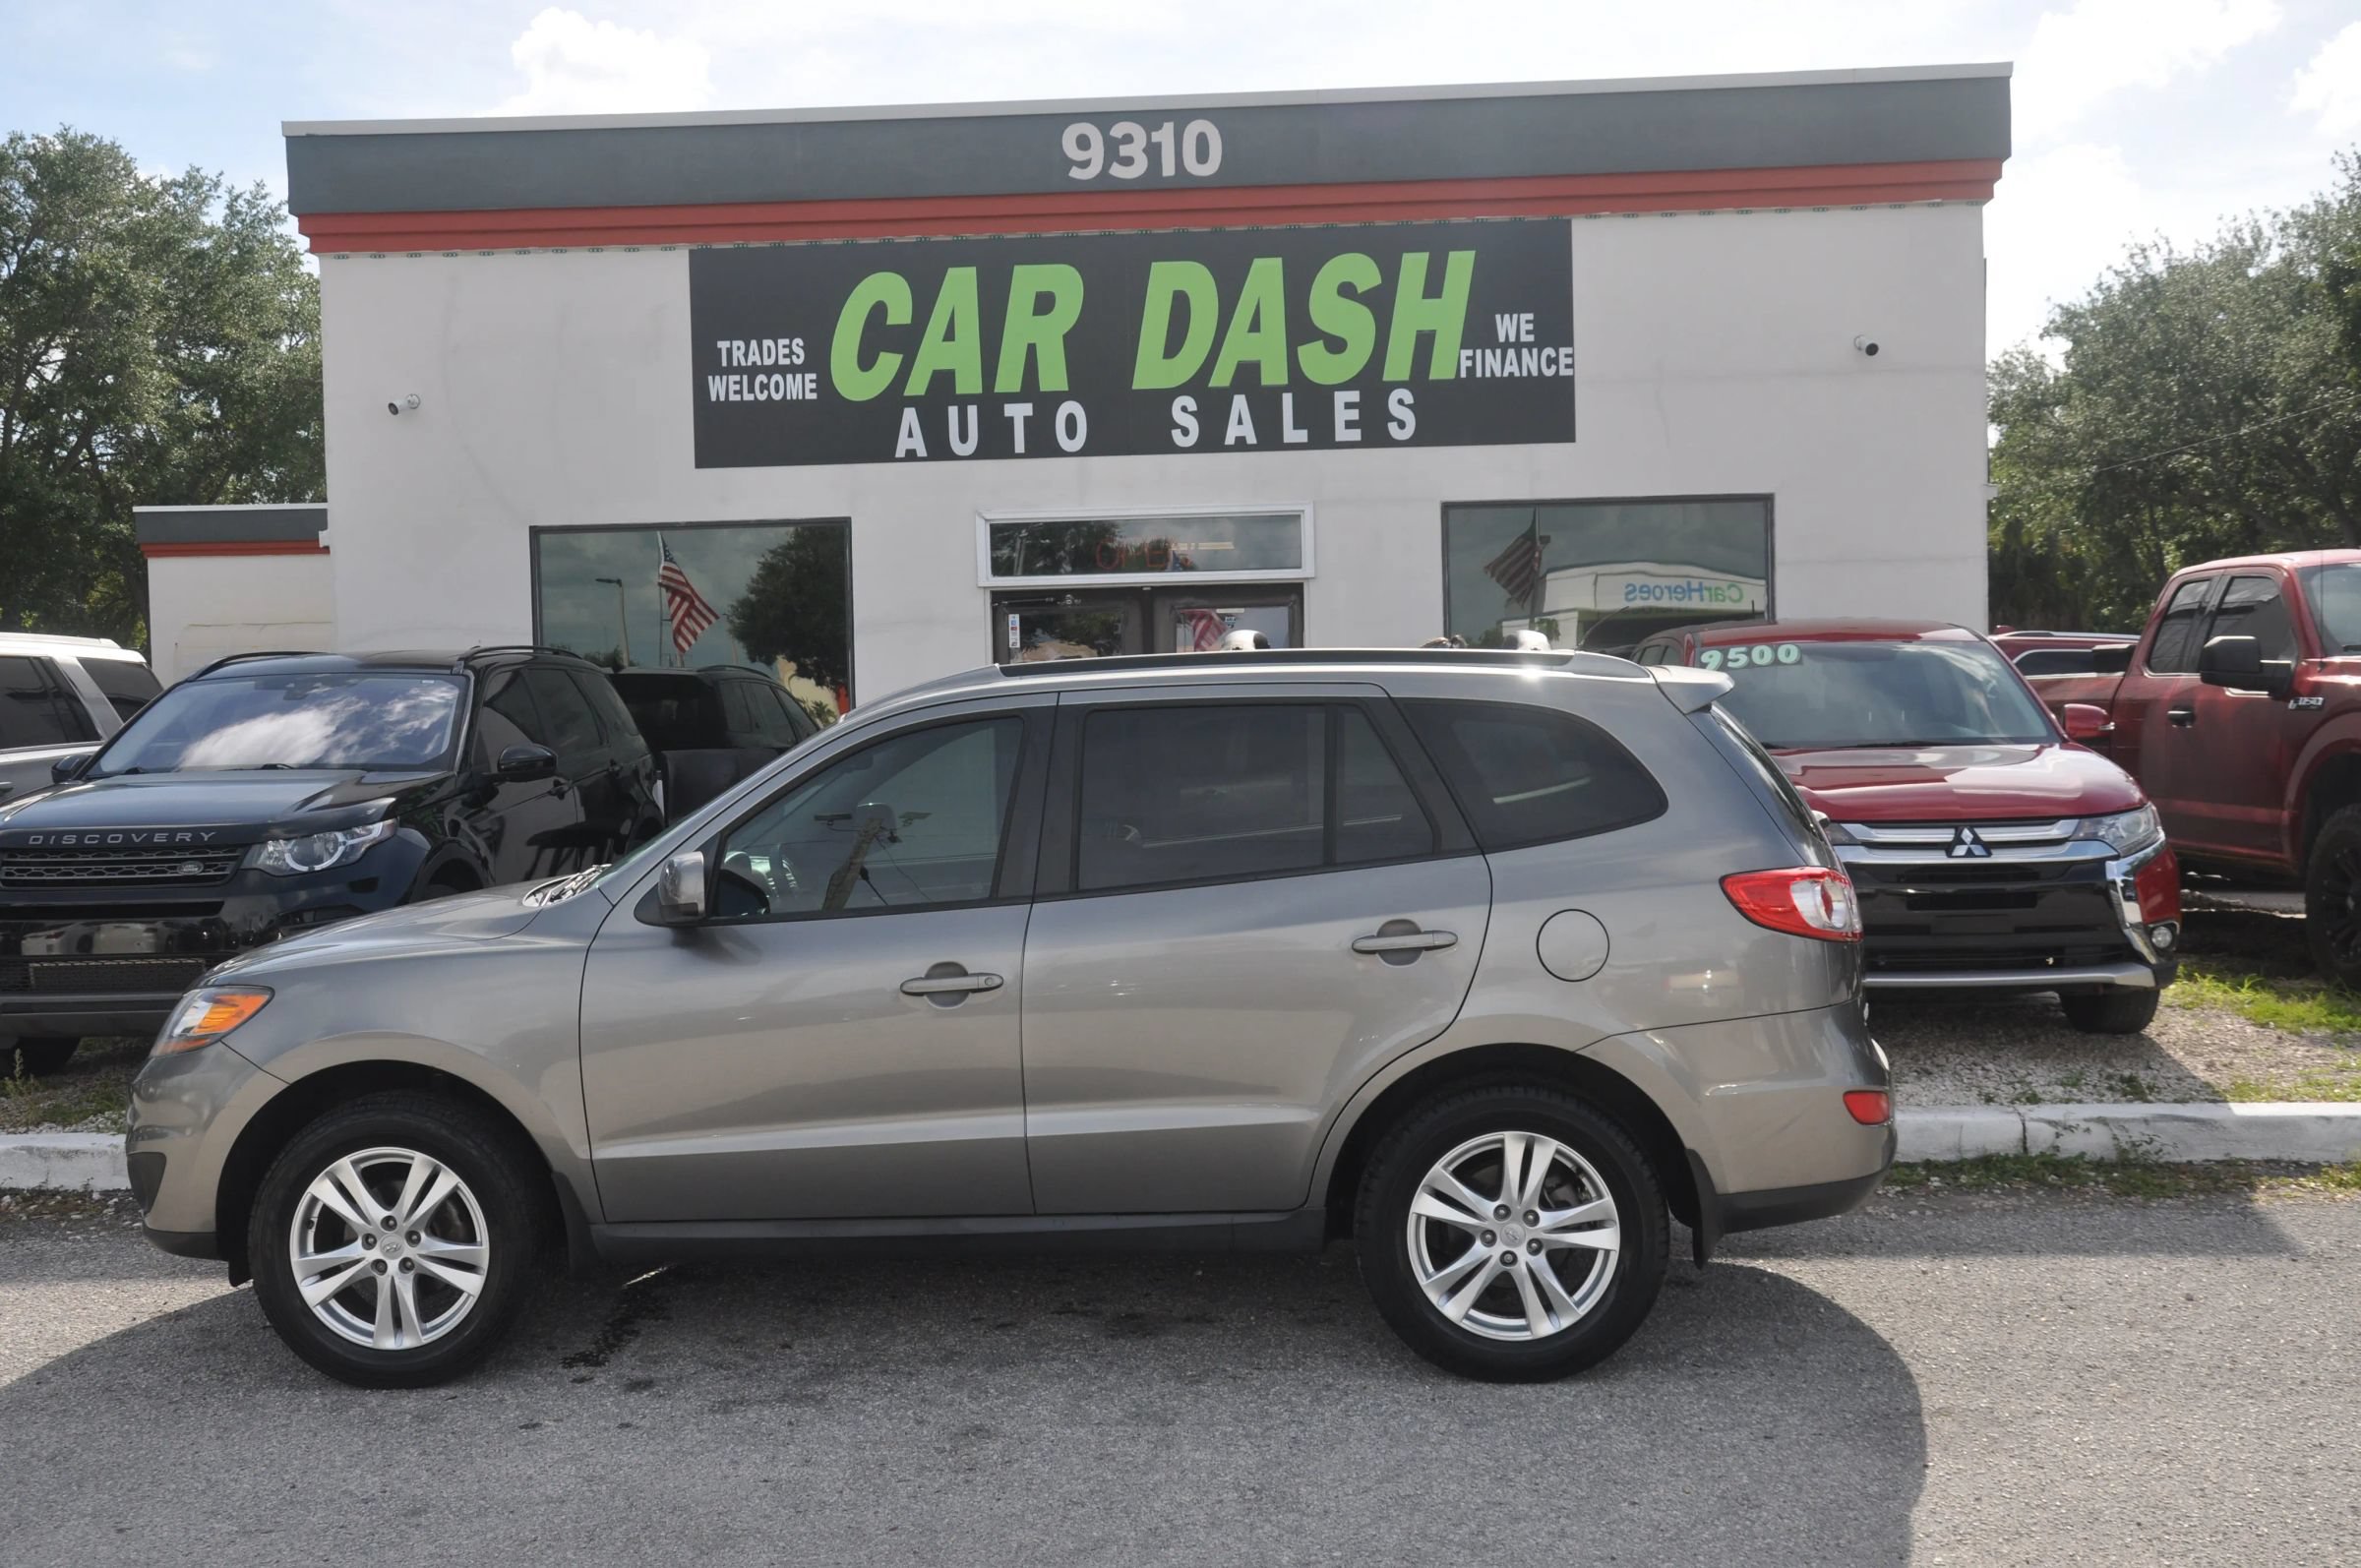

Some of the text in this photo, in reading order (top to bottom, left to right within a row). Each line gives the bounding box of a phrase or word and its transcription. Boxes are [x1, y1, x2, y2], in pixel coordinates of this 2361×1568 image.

[1061, 119, 1223, 180] 9310
[830, 250, 1477, 401] CAR DASH
[1495, 313, 1536, 343] WE
[717, 337, 806, 367] TRADES
[1460, 347, 1574, 378] FINANCE
[708, 373, 817, 402] WELCOME
[894, 389, 1417, 458] AUTO SALES
[1701, 643, 1801, 672] 9500
[29, 831, 215, 845] DISCOVERY
